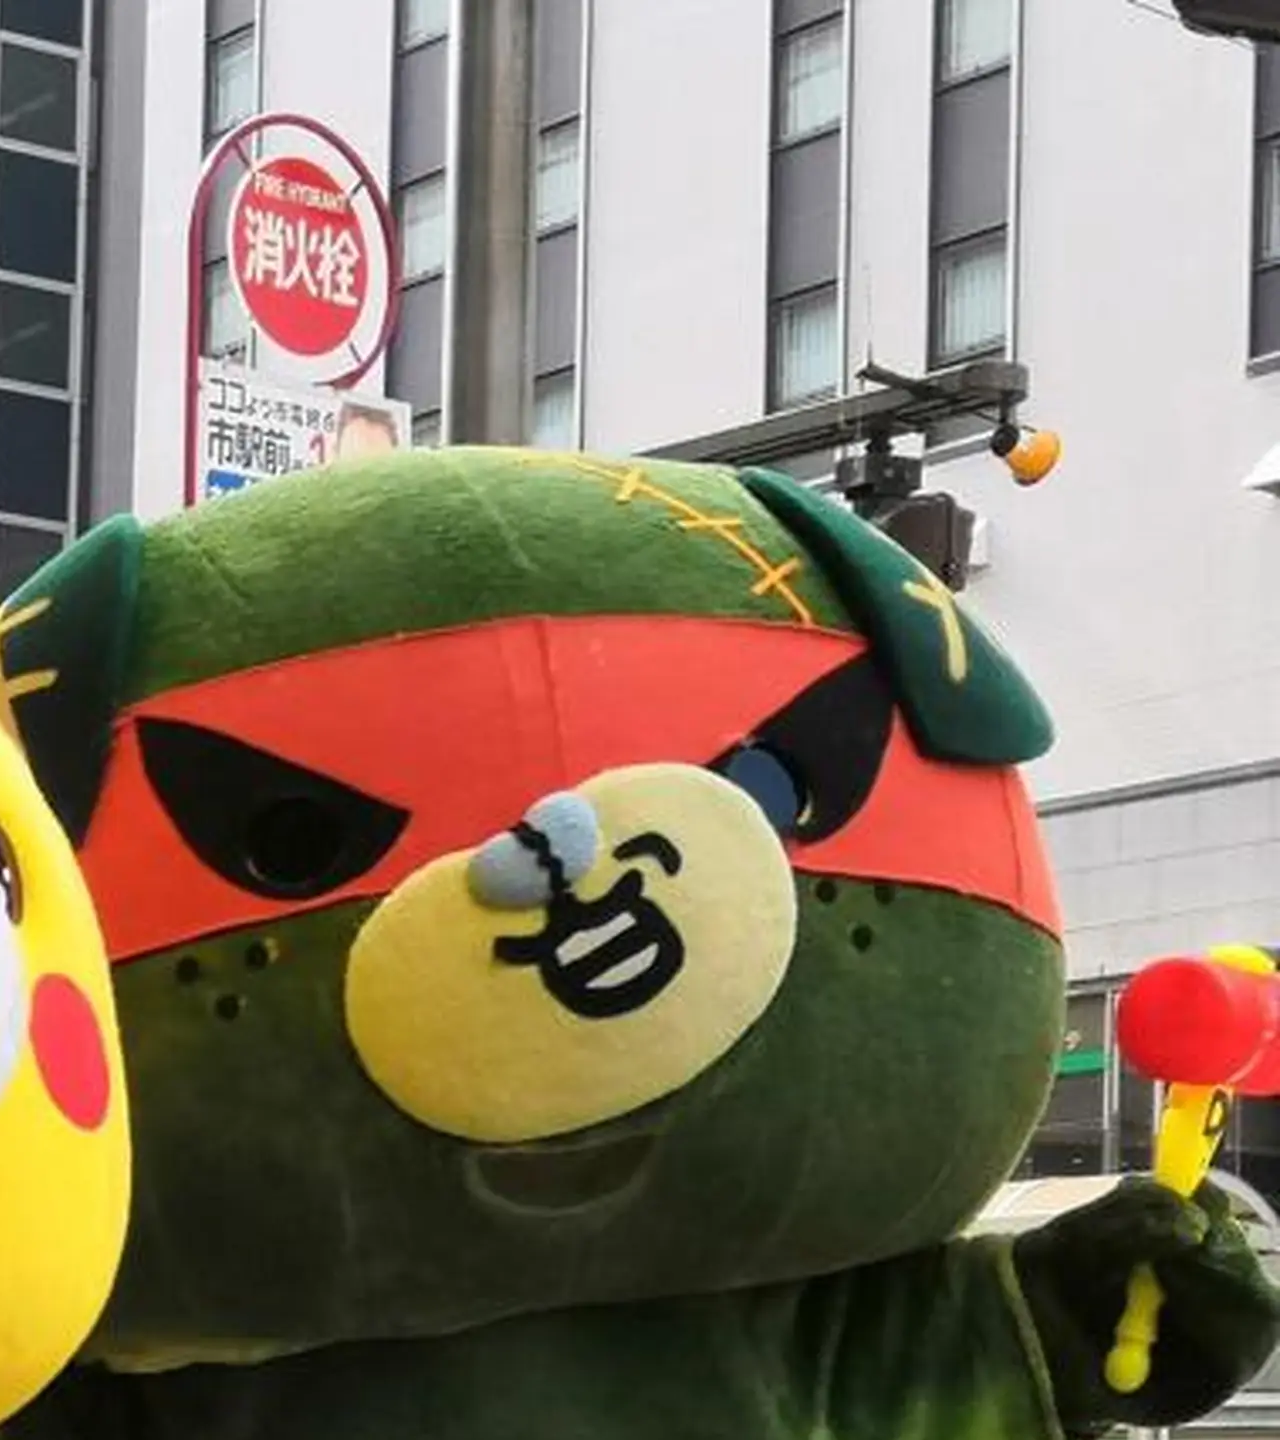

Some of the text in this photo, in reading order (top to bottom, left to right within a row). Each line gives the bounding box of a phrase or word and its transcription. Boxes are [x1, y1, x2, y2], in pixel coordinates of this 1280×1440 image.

[244, 205, 360, 308] 消火栓
[207, 418, 291, 476] 市駅前
